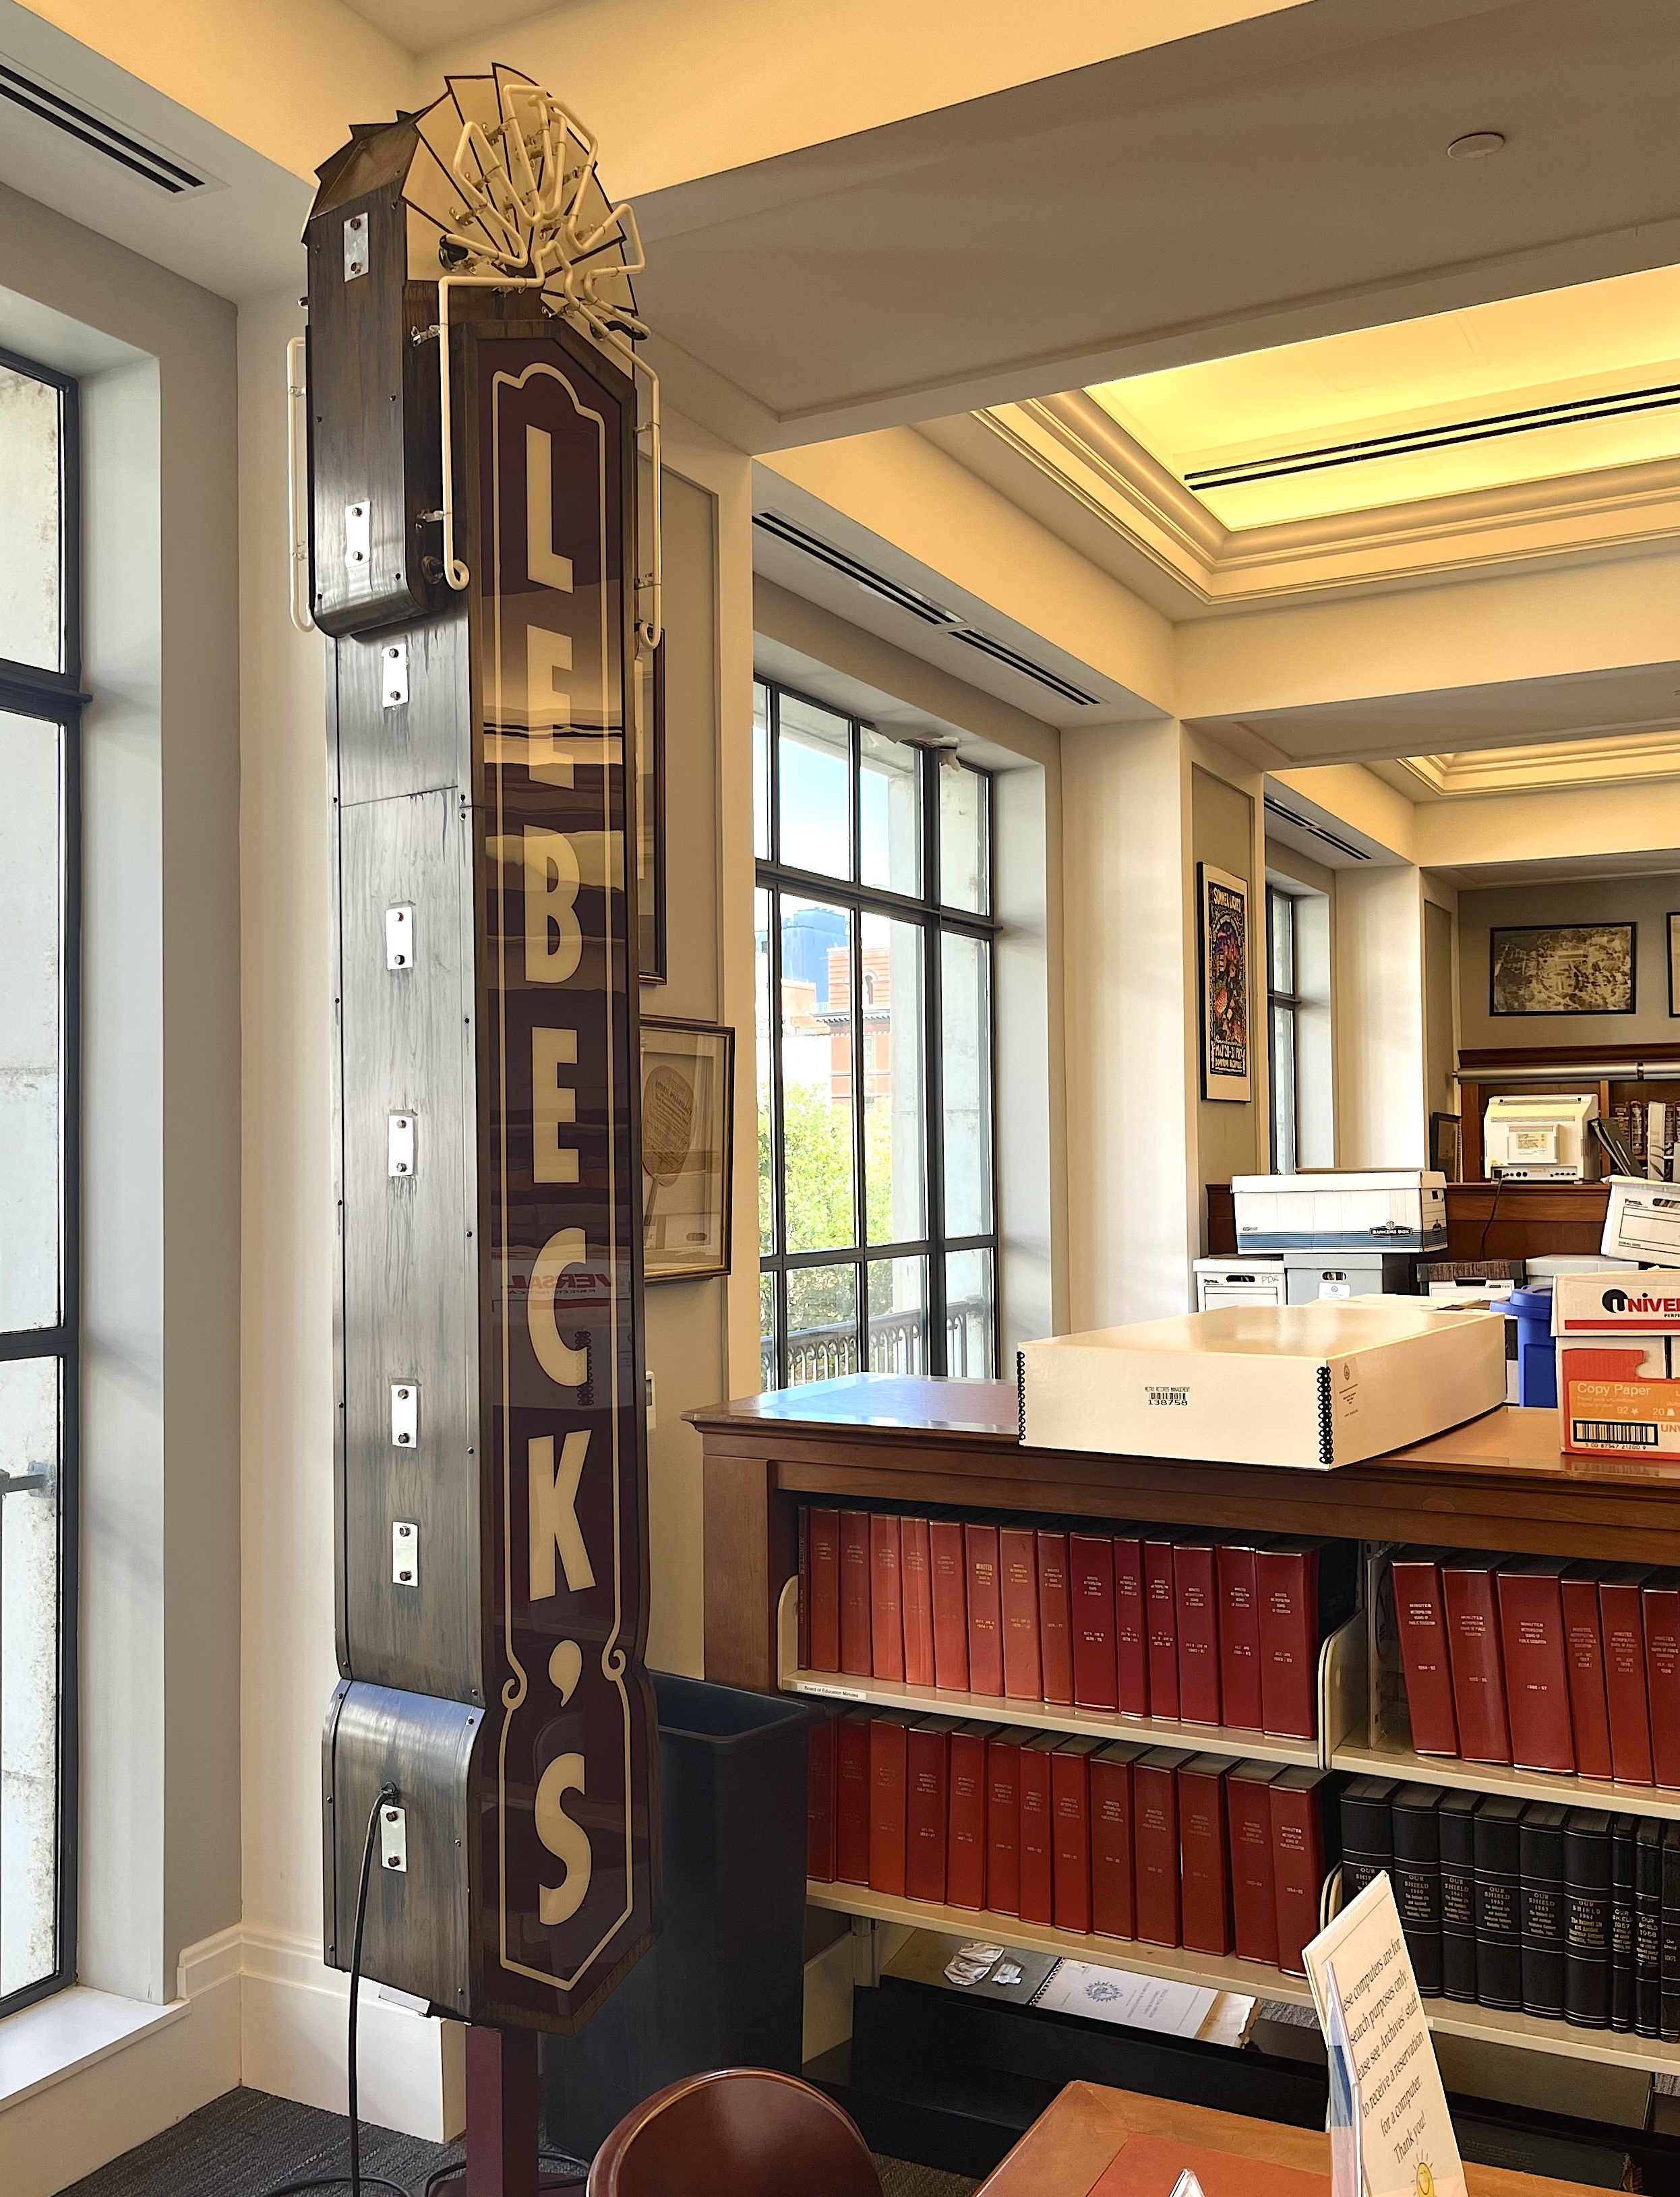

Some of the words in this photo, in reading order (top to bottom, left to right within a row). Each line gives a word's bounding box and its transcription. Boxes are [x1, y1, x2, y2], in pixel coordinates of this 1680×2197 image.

[523, 423, 597, 1927] LEBECK'S
[1602, 1288, 1680, 1314] UNIVE
[1578, 1383, 1611, 1396] Copy
[1614, 1384, 1651, 1397] Paper
[1617, 1406, 1629, 1414] 92
[1652, 1407, 1664, 1416] 20
[1404, 1881, 1429, 1889] SHIELD
[1445, 1883, 1469, 1892] SHIELD
[1484, 1892, 1510, 1900] SHIELD
[1528, 1897, 1555, 1907] SHIELD
[1572, 1904, 1600, 1915] SHIELD
[1343, 1993, 1354, 2012] ese
[1353, 1958, 1384, 2000] computers
[1383, 1948, 1393, 1966] are
[1391, 1938, 1402, 1956] for
[1369, 1985, 1396, 2030] purposes
[1394, 1968, 1410, 1993] only.
[1358, 2057, 1371, 2081] ease
[1370, 2045, 1381, 2065] see
[1379, 2006, 1406, 2053] Archives'
[1404, 1991, 1418, 2020] staff
[1362, 2102, 1371, 2118] to
[1369, 2074, 1391, 2110] receive
[1389, 2069, 1396, 2083] a
[1393, 2030, 1424, 2077] reservation
[1380, 2115, 1391, 2138] for
[1390, 2111, 1397, 2125] a
[1394, 2075, 1423, 2118] computer.
[1393, 2128, 1414, 2164] Thank
[1412, 2109, 1427, 2146] you!
